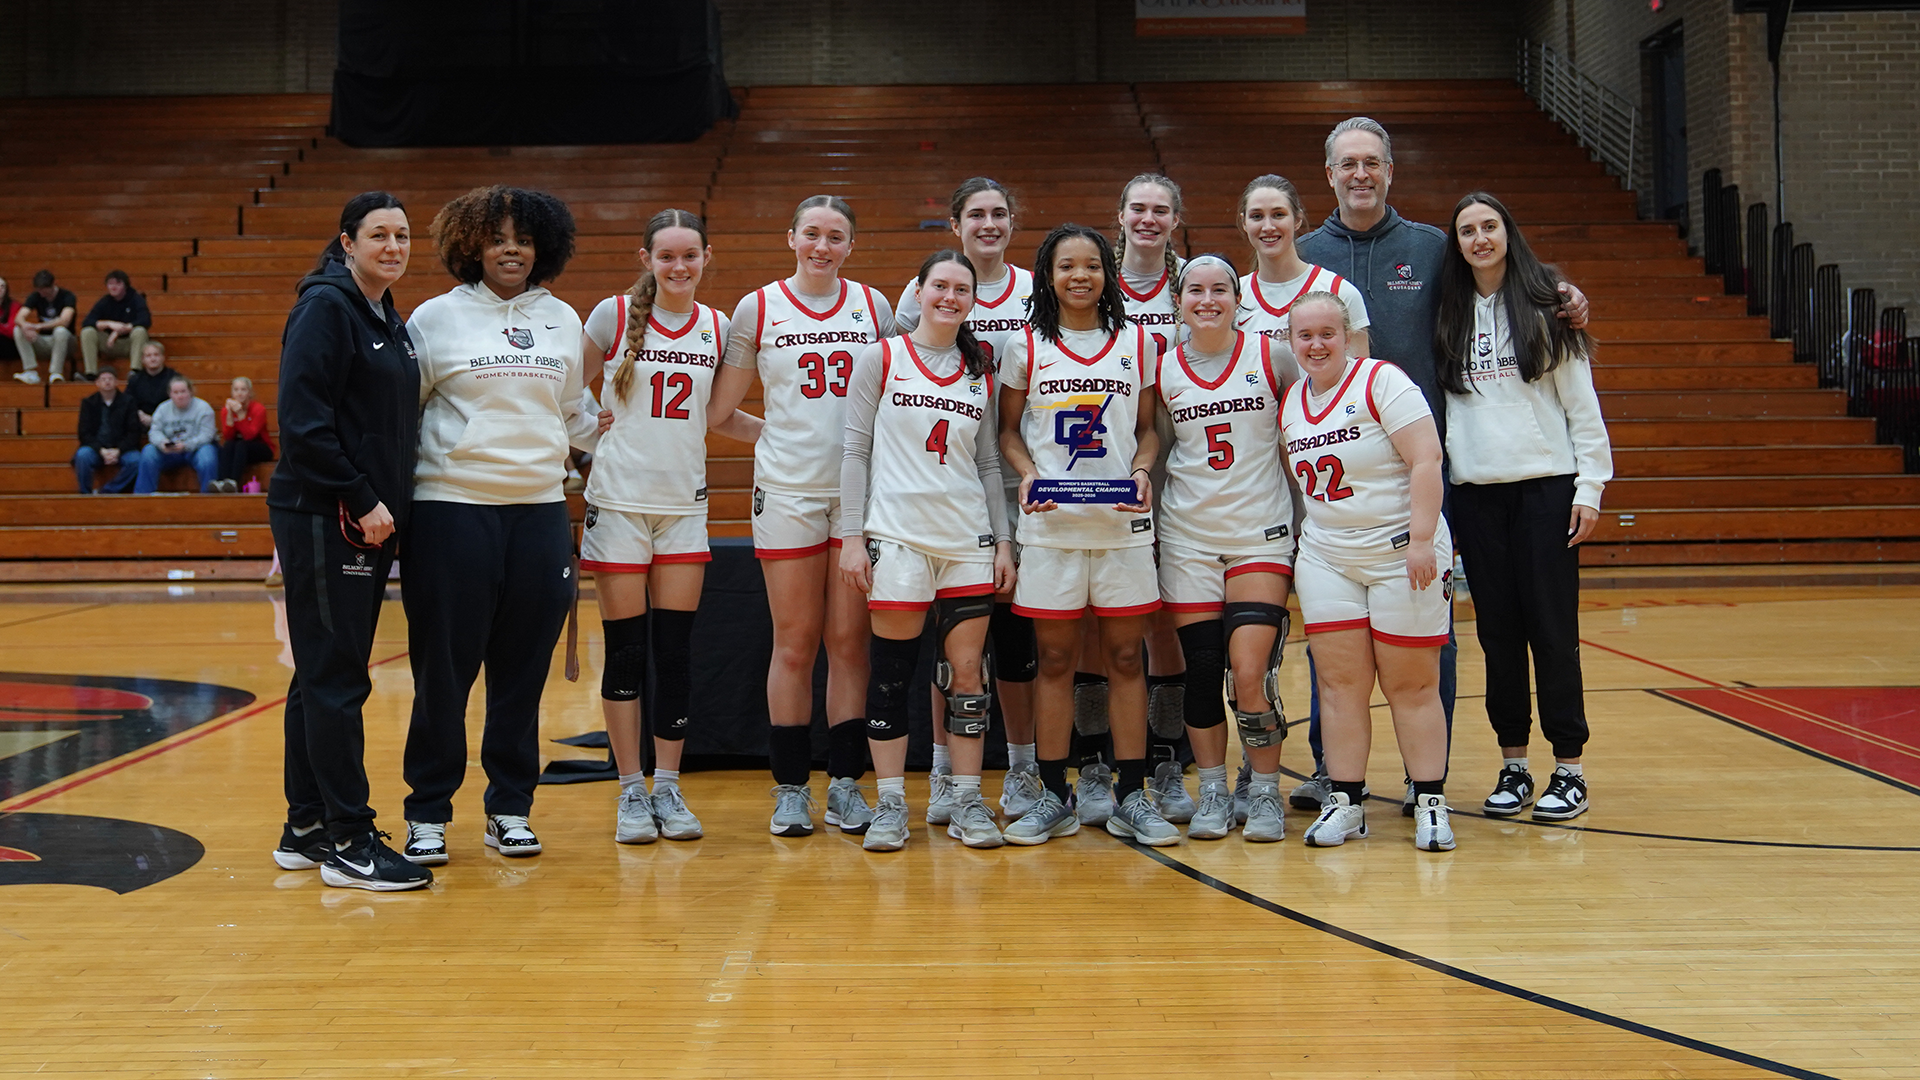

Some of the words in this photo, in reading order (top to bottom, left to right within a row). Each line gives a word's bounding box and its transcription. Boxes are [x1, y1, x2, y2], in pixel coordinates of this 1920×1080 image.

[774, 331, 868, 348] CRUSADERS
[469, 354, 532, 368] BELMONT
[534, 354, 563, 370] ABBEY
[475, 370, 517, 380] WOMEN'S
[517, 371, 562, 383] BASKETBALL
[798, 350, 853, 399] 33
[650, 370, 693, 420] 12
[1039, 378, 1132, 397] CRUSADERS
[892, 392, 983, 421] CRUSADERS
[1172, 396, 1265, 424] CRUSADERS
[925, 418, 950, 465] 4
[1204, 422, 1235, 471] 5
[1295, 454, 1354, 502] 22
